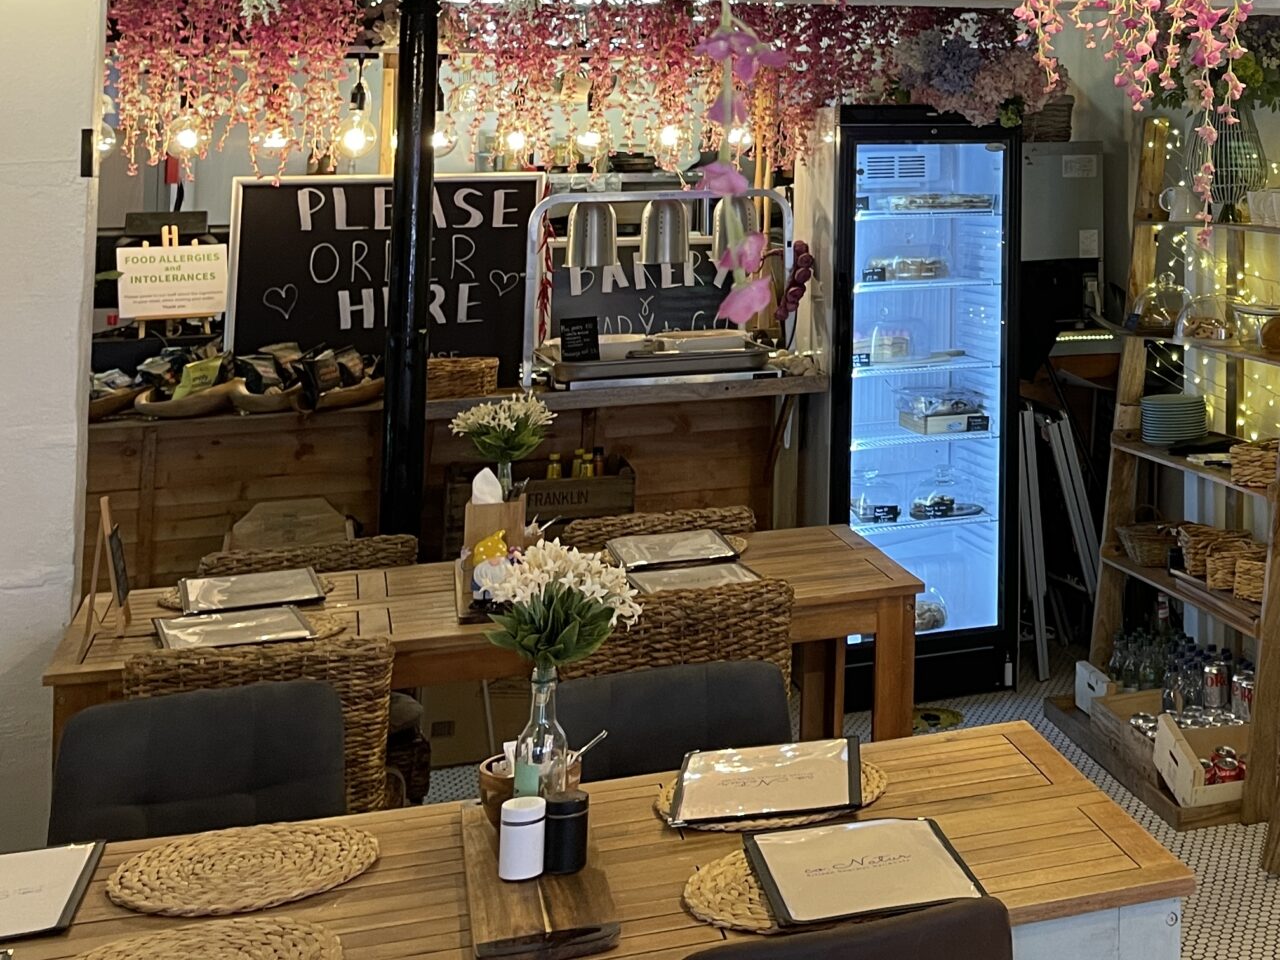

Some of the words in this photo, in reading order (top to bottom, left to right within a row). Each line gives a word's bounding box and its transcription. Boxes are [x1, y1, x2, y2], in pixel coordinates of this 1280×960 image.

[124, 256, 156, 265] FOOD
[160, 253, 220, 263] ALLERGIES
[164, 264, 182, 272] and
[309, 234, 476, 284] ORR
[130, 272, 216, 284] INTOLERANCES
[337, 282, 484, 331] HRE
[597, 313, 655, 336] ADY
[526, 489, 589, 508] FRANKLIN
